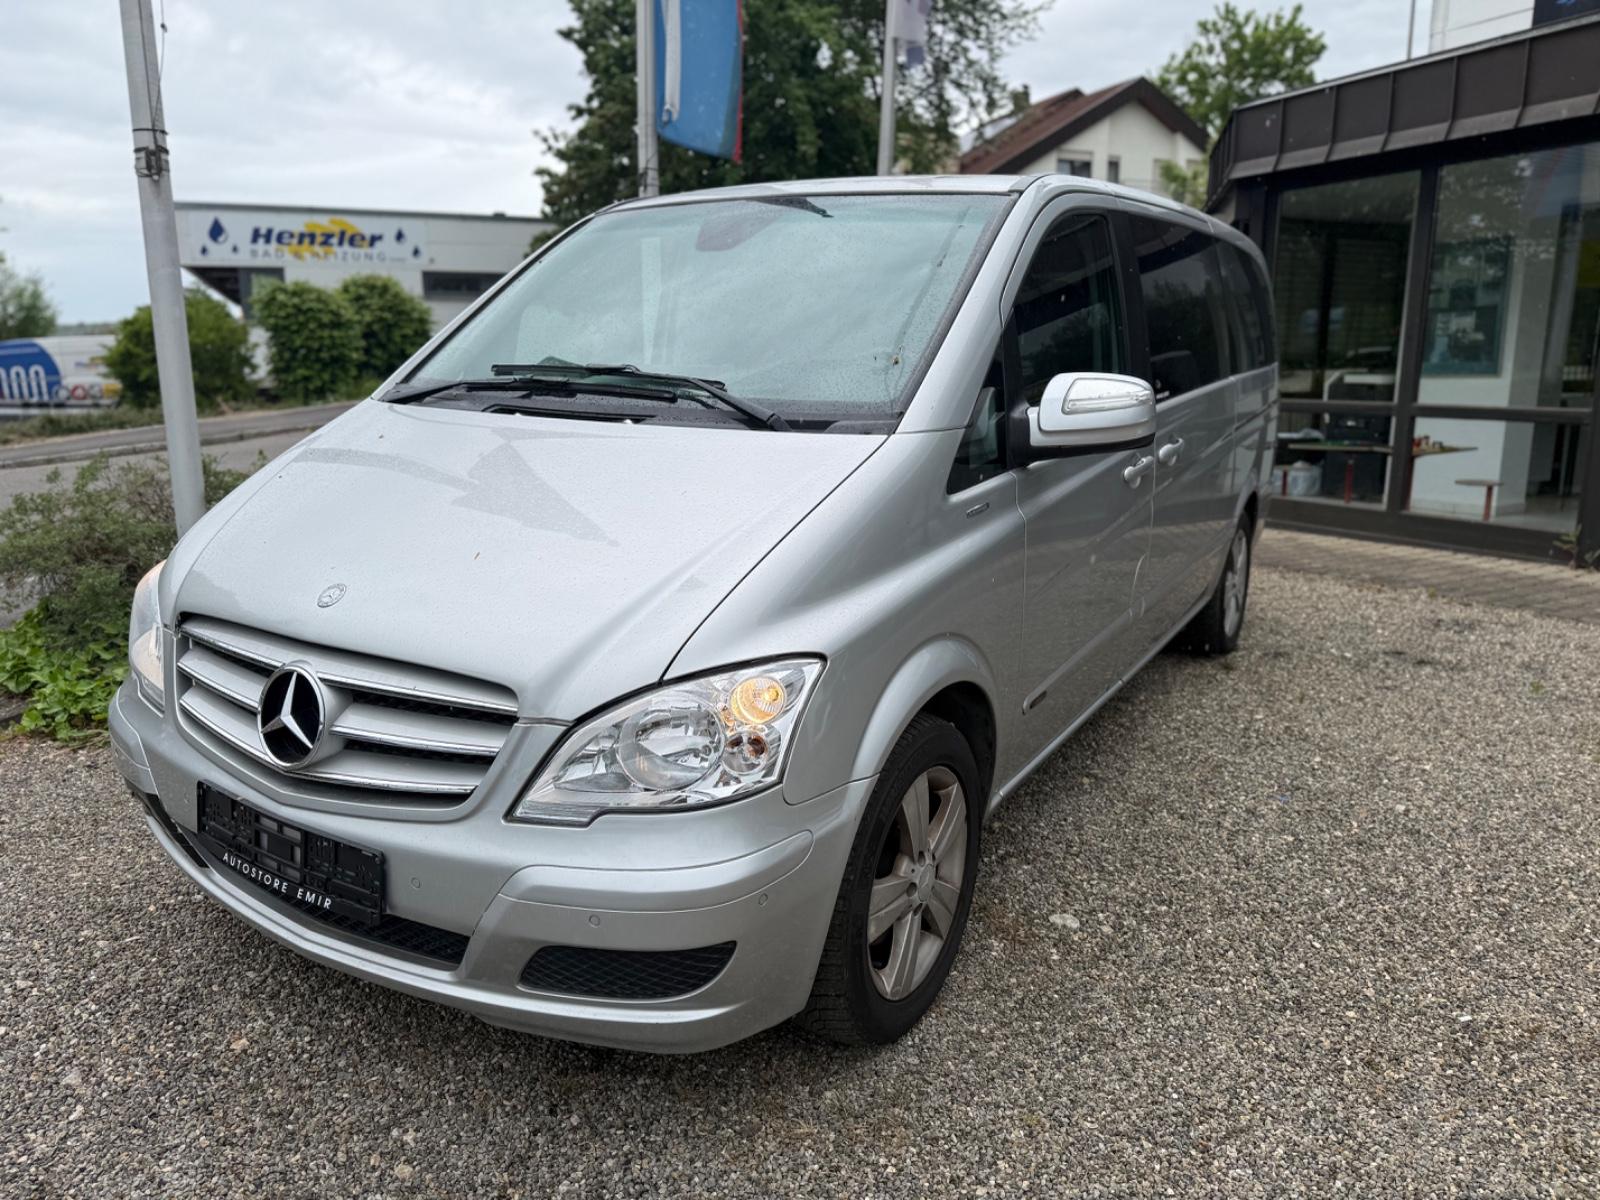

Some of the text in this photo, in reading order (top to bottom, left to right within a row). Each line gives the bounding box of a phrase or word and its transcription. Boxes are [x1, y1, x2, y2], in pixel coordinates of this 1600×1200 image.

[250, 227, 383, 248] Henzler
[250, 249, 285, 260] BAD
[222, 852, 332, 909] AUTOSTORE EMIR
